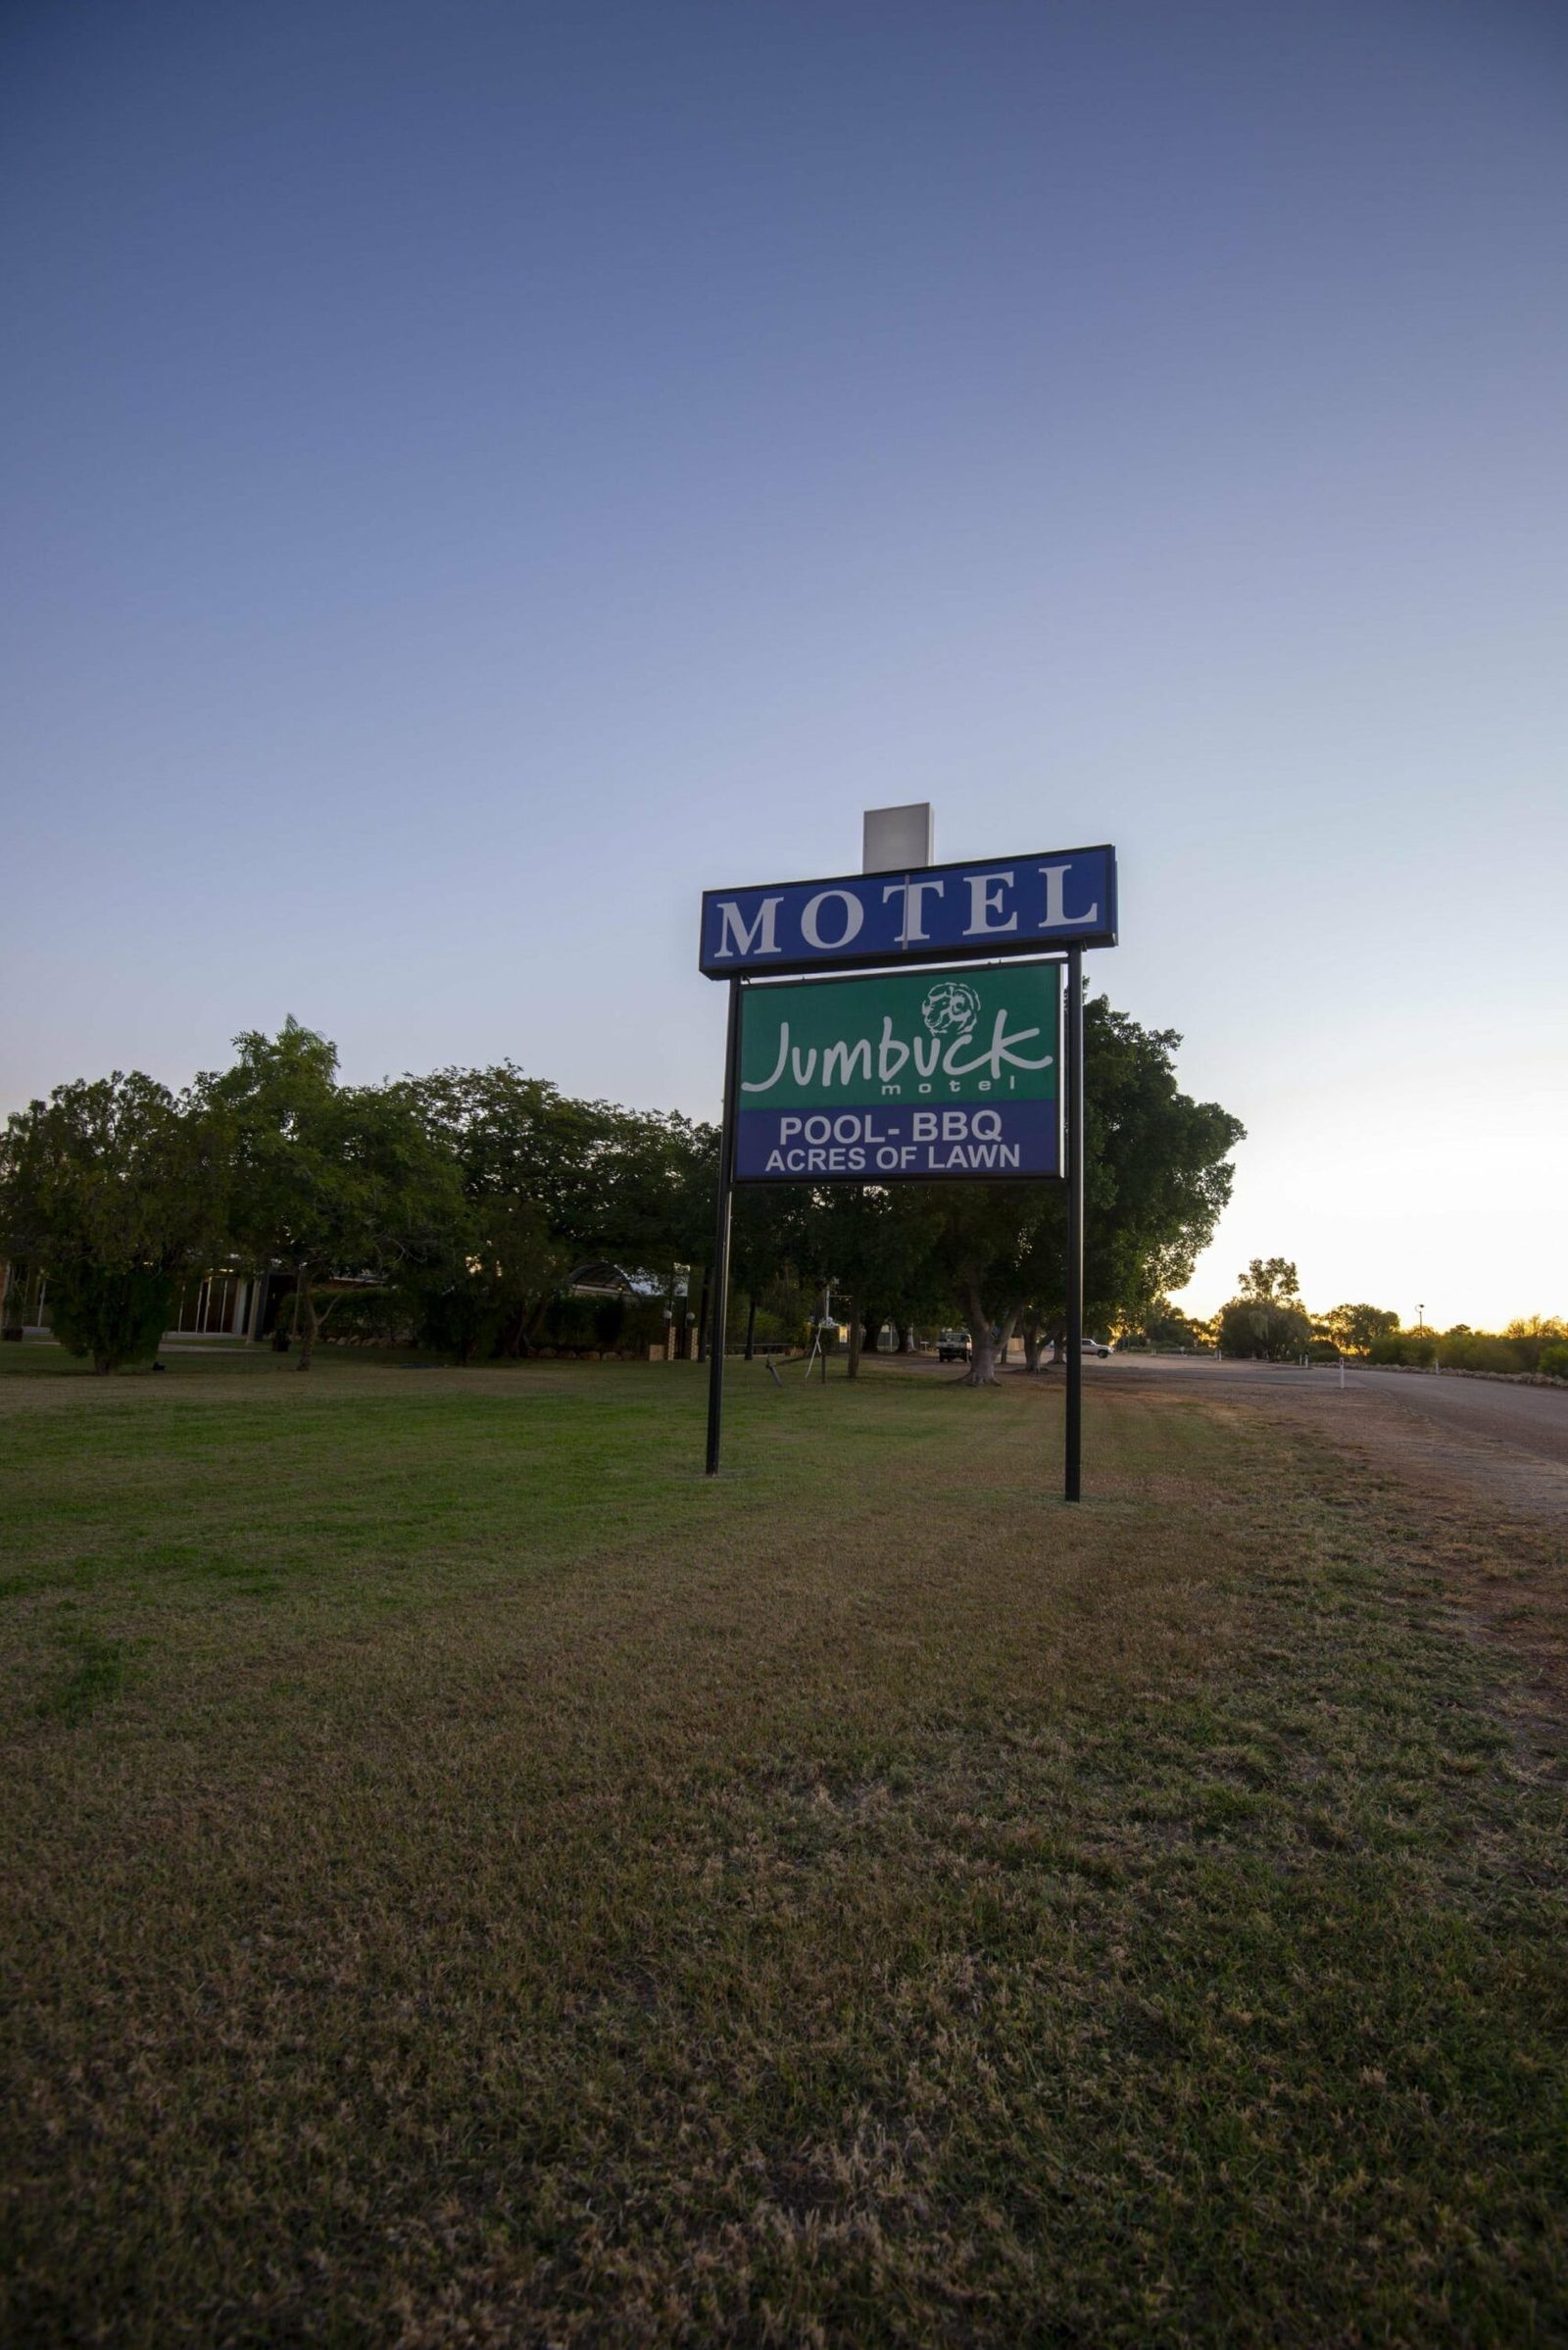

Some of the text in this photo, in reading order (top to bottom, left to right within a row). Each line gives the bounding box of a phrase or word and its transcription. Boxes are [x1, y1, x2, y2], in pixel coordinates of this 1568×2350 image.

[714, 863, 1098, 958] MOTEL
[741, 1008, 1054, 1093] Jumbuck
[881, 1075, 1015, 1096] motel
[912, 1109, 1003, 1143] BBQ
[764, 1143, 1020, 1172] ACRES OF LAWN
